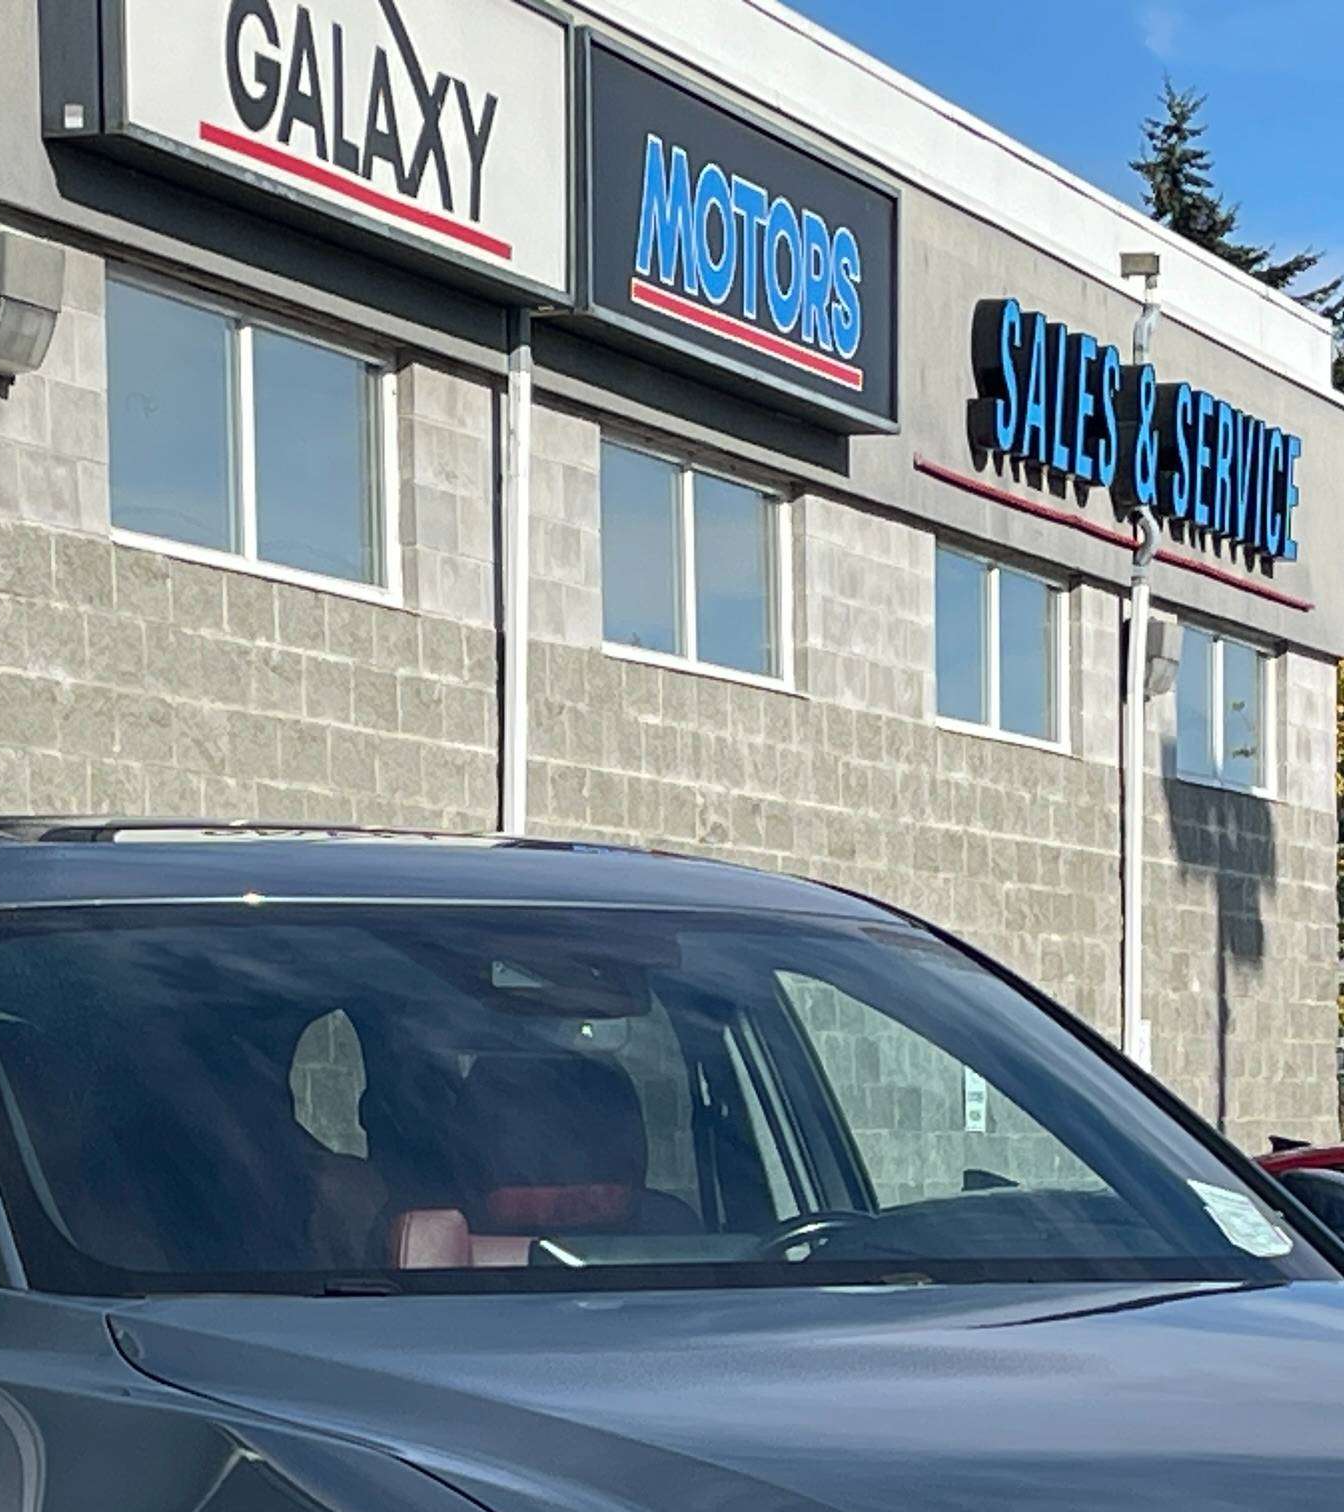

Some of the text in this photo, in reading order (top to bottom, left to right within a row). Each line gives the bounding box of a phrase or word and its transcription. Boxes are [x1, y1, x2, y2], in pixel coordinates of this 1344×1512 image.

[226, 0, 498, 222] GALAXY
[636, 133, 860, 359] MOTORS
[996, 297, 1302, 562] SALES & SERVICE
